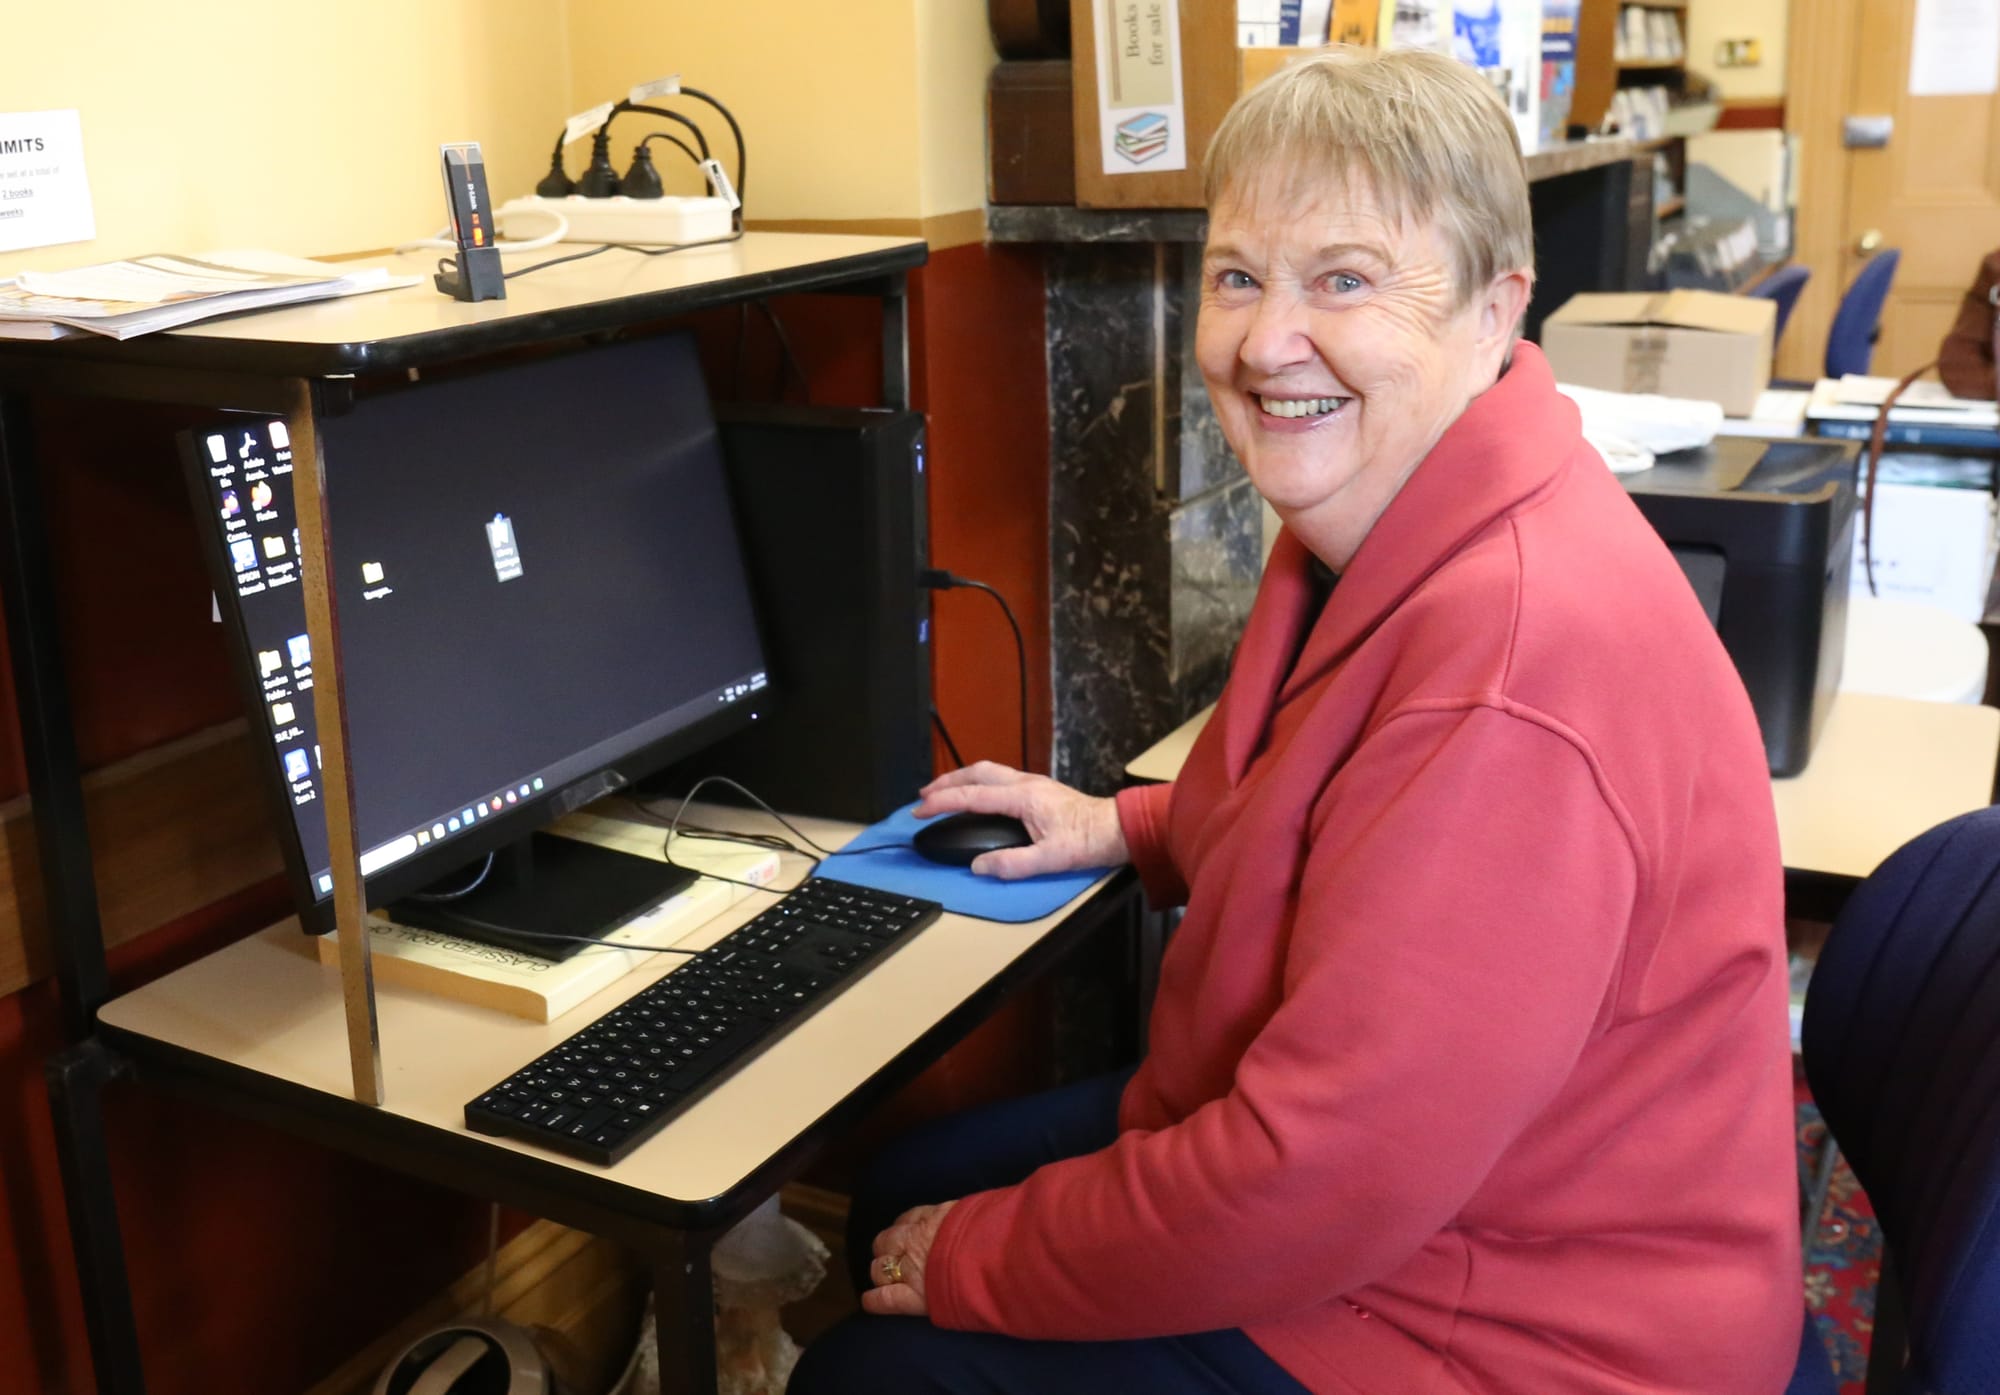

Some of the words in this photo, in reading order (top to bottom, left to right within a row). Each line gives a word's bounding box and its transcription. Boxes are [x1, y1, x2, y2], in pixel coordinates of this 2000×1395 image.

[1124, 4, 1140, 58] Books
[1146, 3, 1162, 36] sale
[1147, 43, 1164, 66] for
[1, 189, 7, 200] 2
[8, 187, 34, 199] books
[467, 183, 478, 210] D-Link
[394, 929, 445, 947] ROLL
[442, 940, 551, 974] CLASSIFIED
